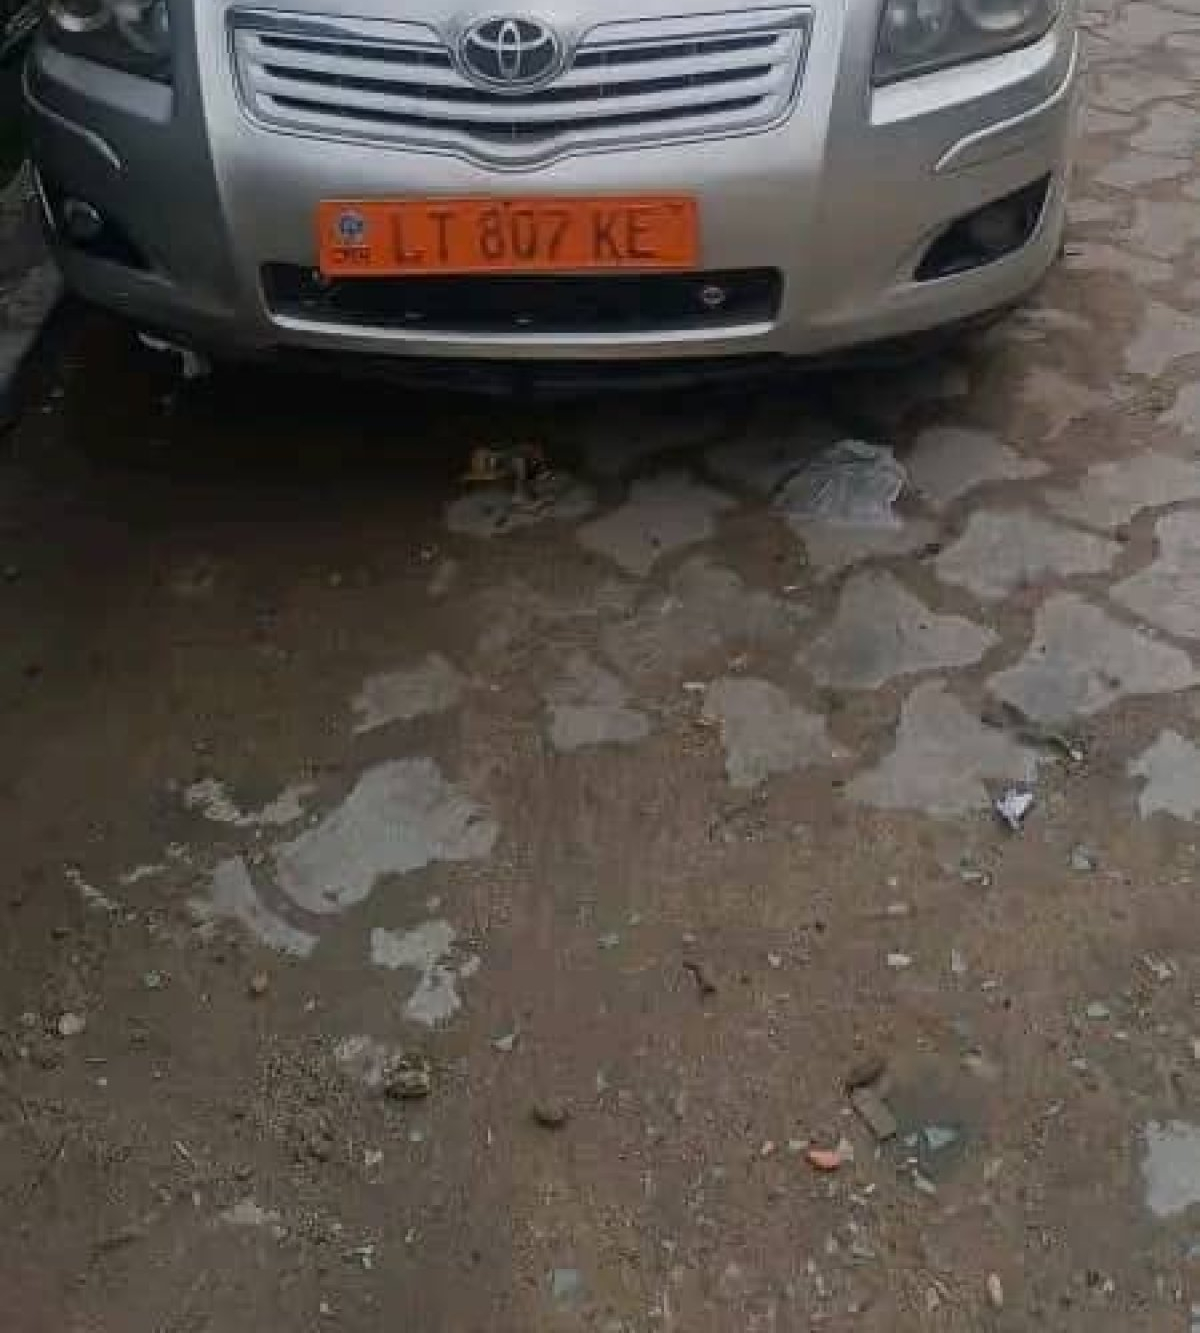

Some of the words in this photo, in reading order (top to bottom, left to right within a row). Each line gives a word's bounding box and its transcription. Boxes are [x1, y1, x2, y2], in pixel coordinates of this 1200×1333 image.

[391, 211, 455, 264] LT
[479, 208, 574, 261] 807
[593, 208, 659, 260] KE
